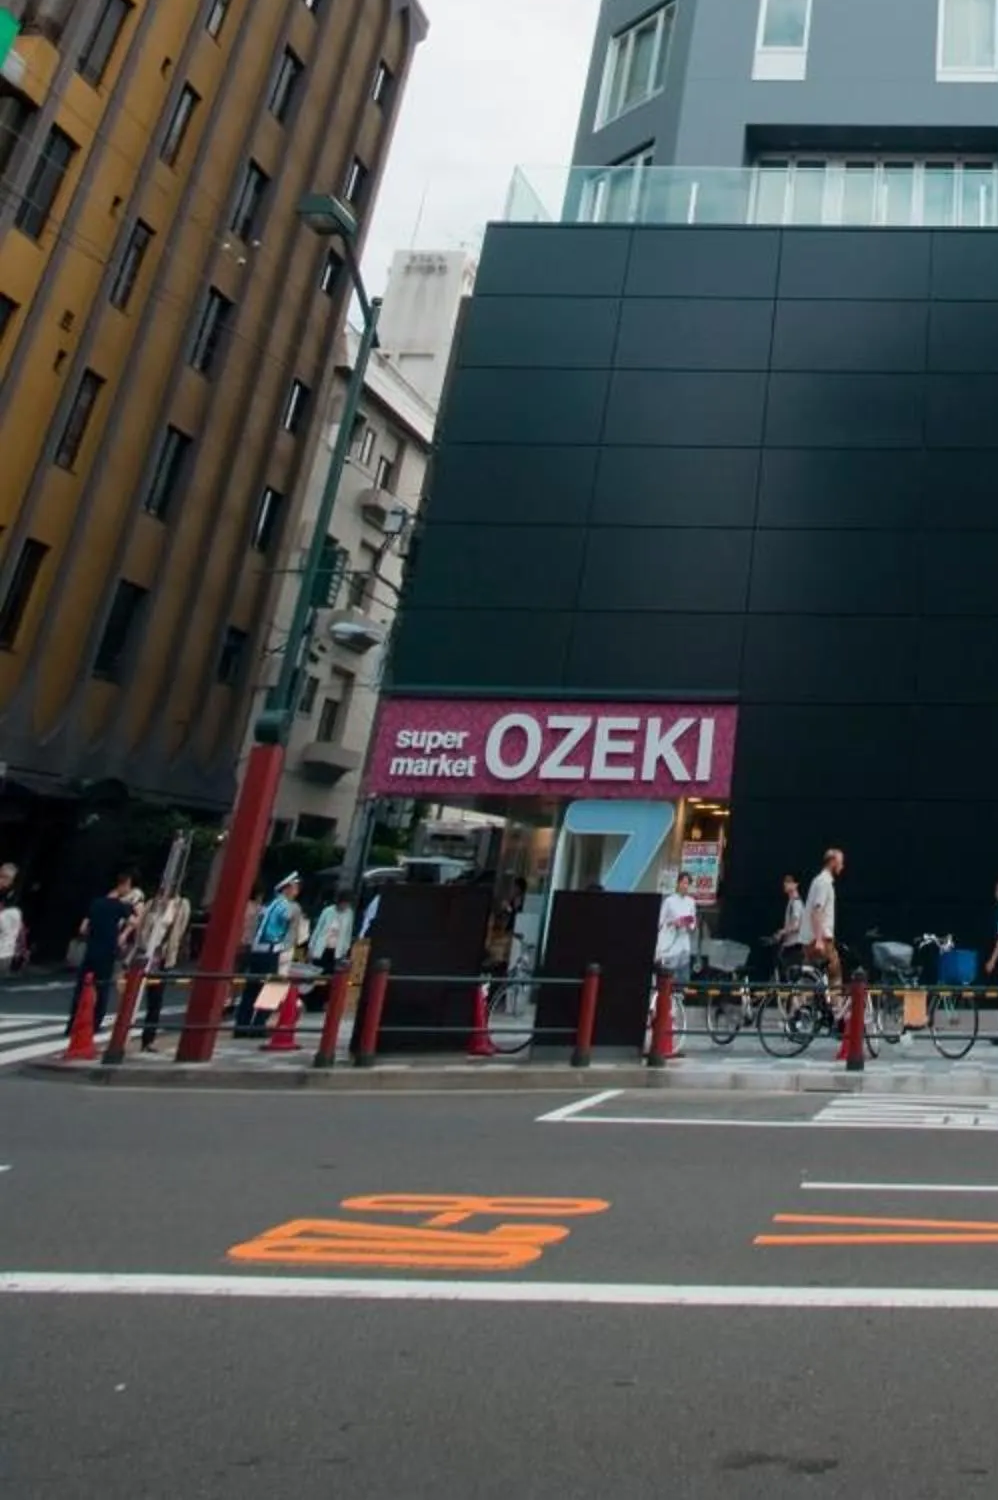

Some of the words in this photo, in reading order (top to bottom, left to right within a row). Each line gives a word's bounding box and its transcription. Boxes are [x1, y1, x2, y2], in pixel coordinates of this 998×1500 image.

[395, 729, 469, 754] super
[484, 712, 716, 782] OZEKI
[389, 754, 477, 778] market
